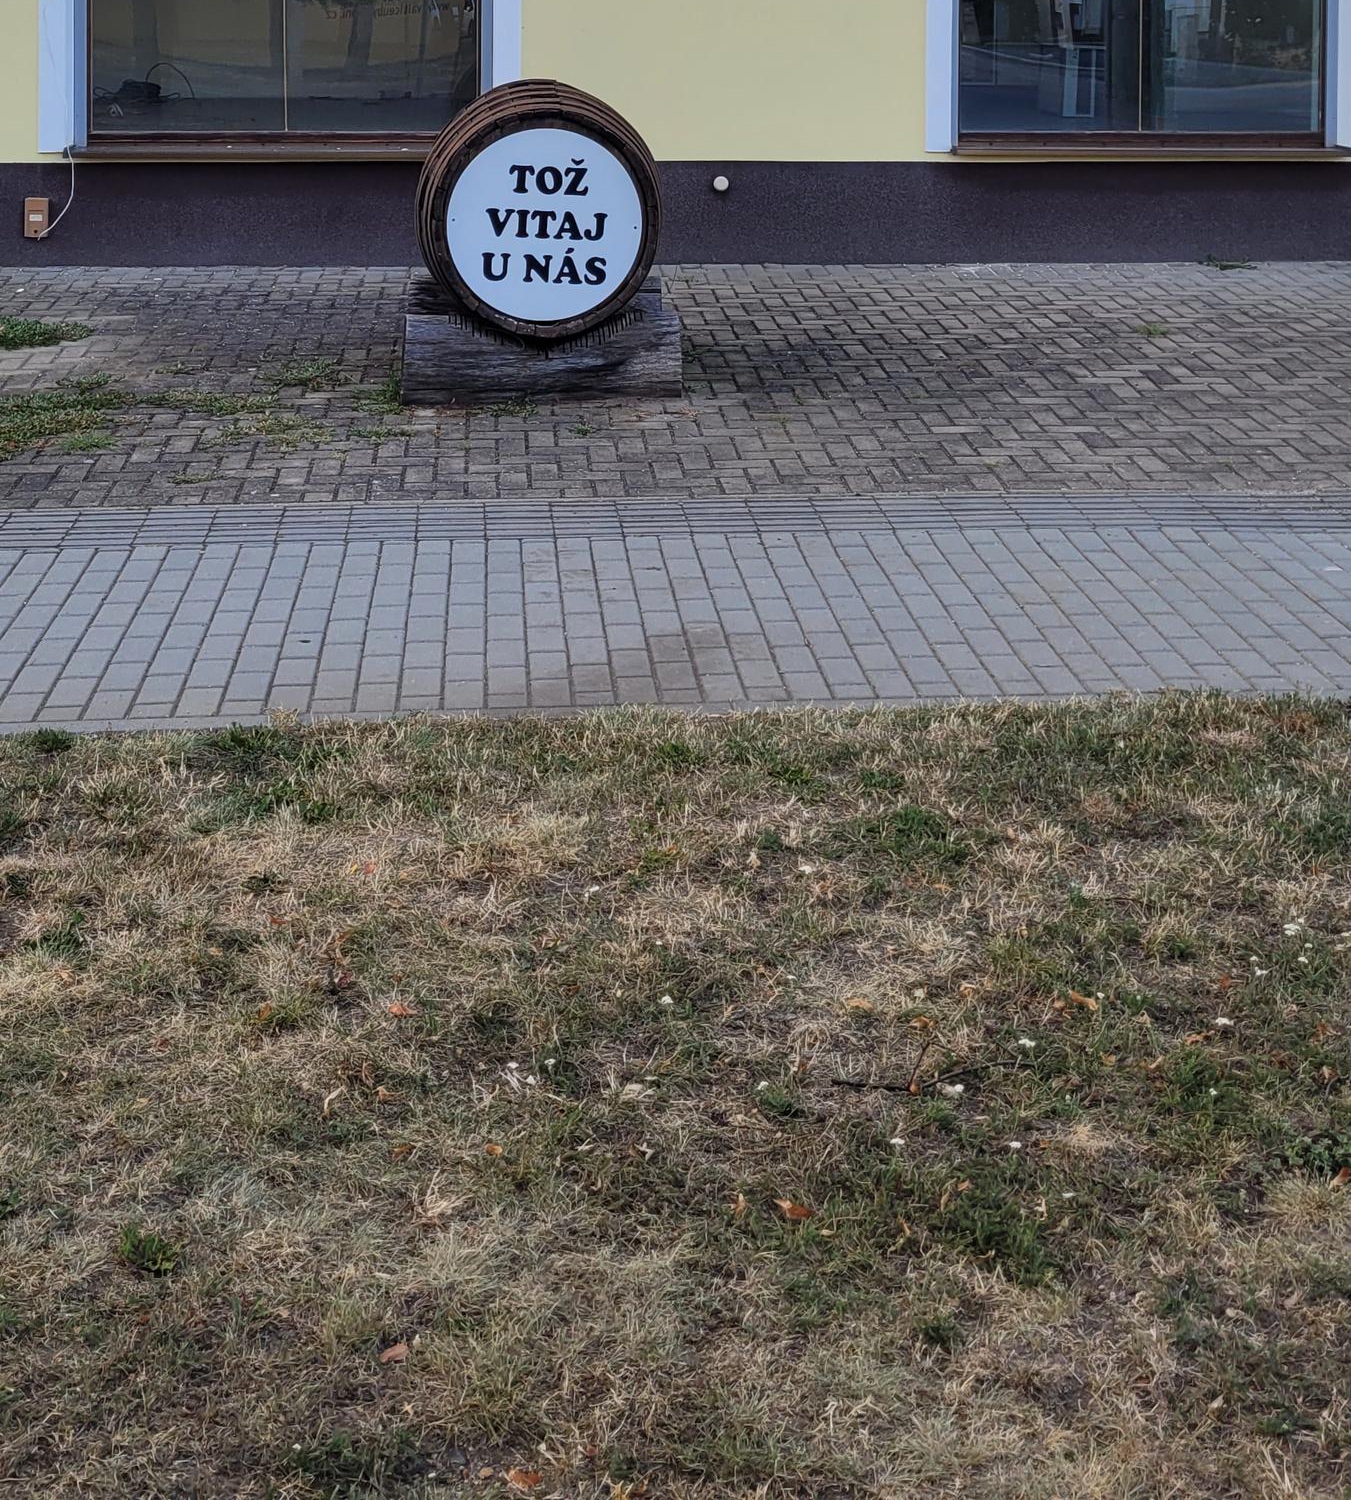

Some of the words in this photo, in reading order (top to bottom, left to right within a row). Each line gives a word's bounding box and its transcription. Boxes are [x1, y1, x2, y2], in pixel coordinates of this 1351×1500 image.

[509, 159, 588, 196] TOŽ
[486, 208, 608, 241] VITAJ
[482, 252, 511, 281] U
[523, 248, 606, 285] NÁS
